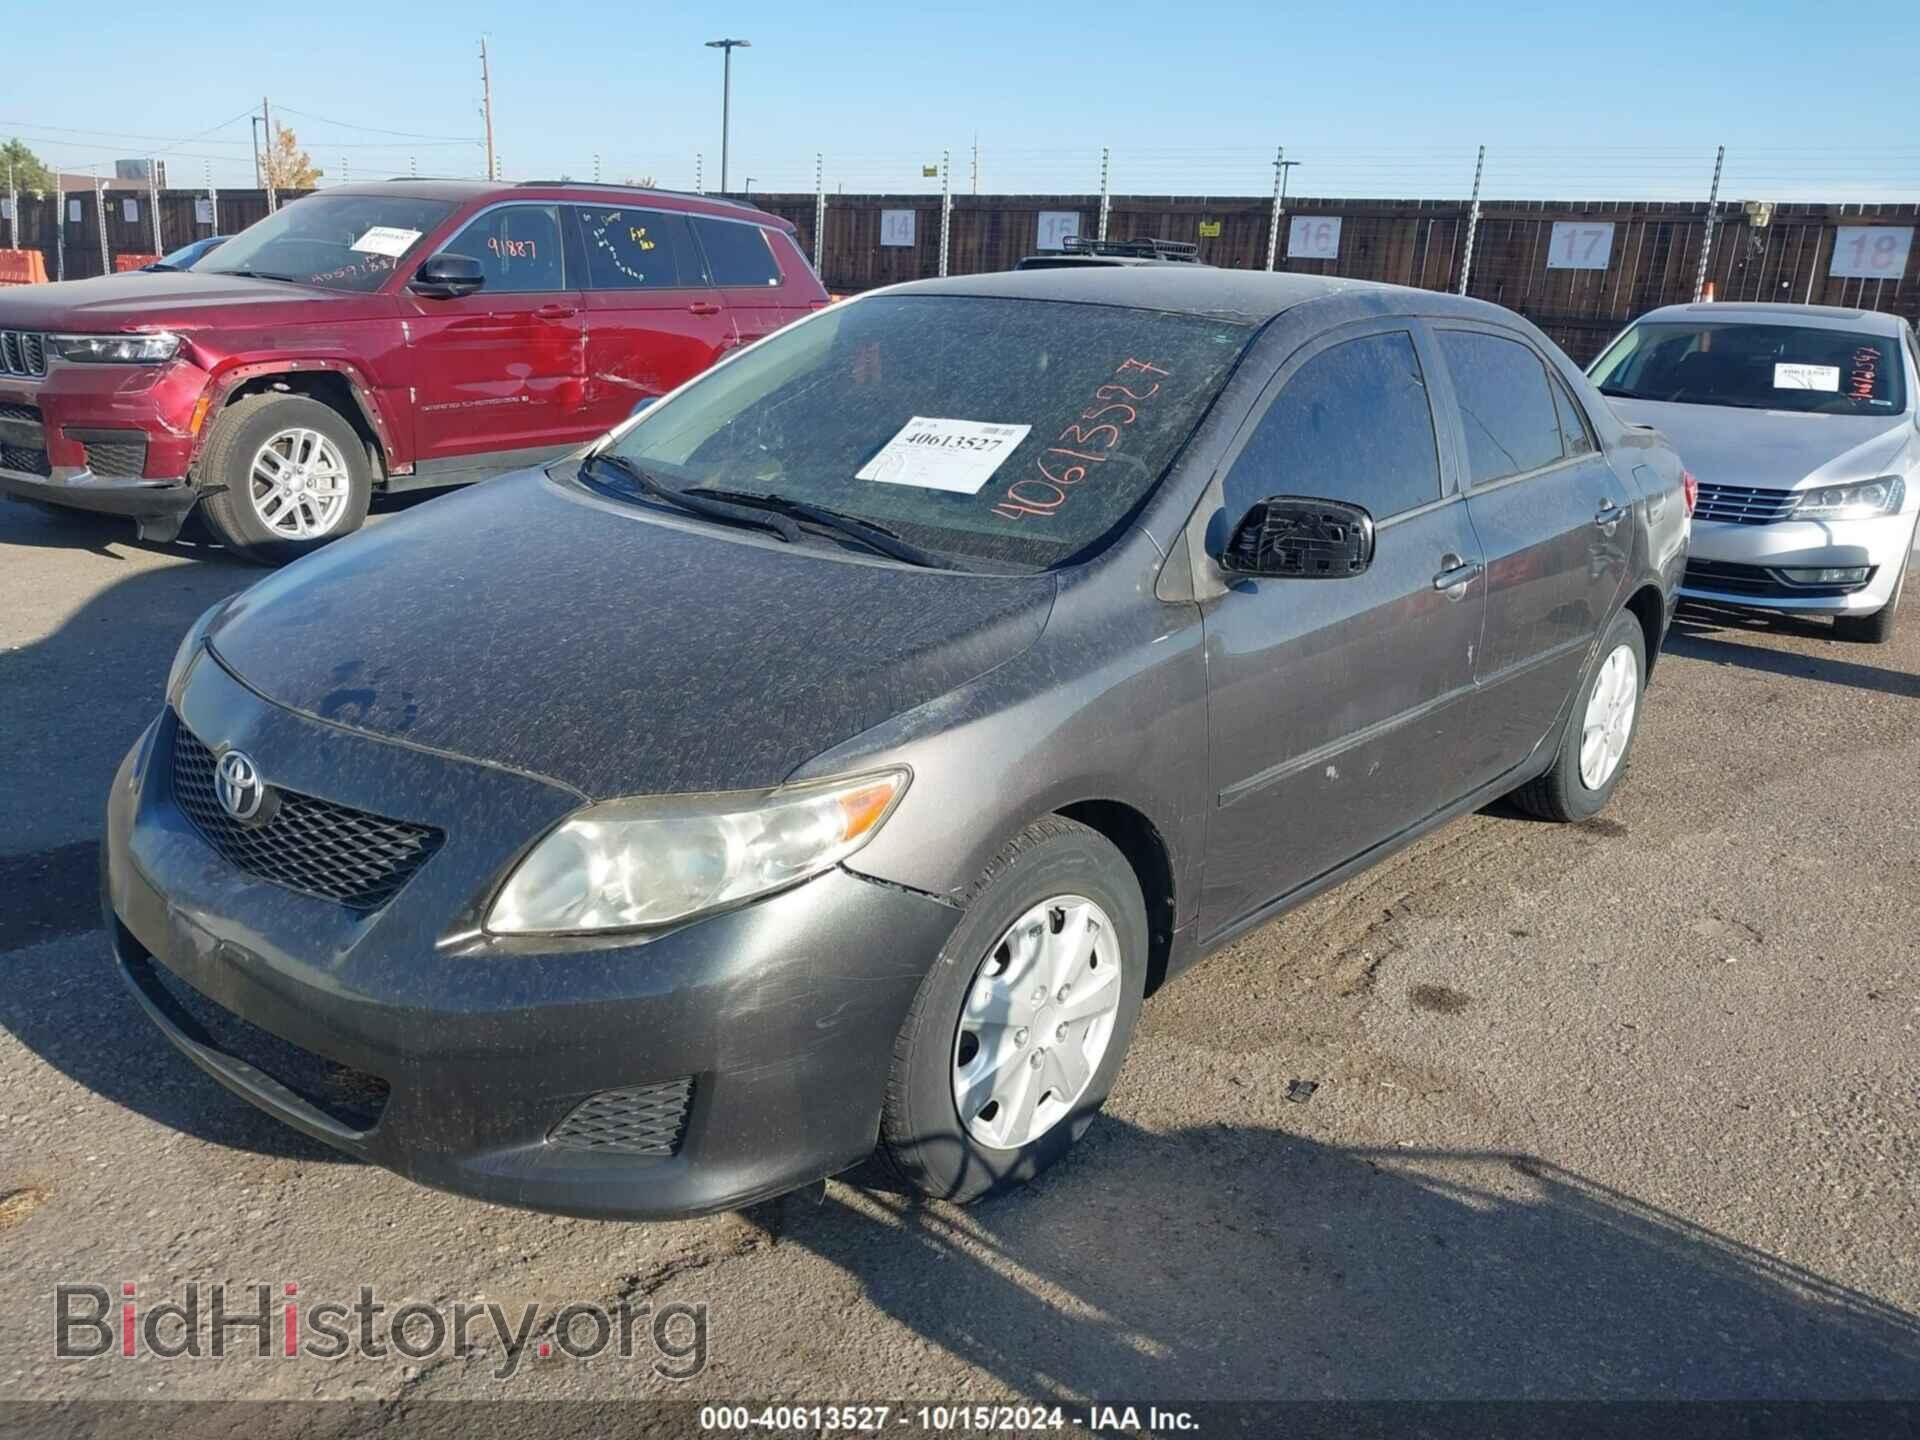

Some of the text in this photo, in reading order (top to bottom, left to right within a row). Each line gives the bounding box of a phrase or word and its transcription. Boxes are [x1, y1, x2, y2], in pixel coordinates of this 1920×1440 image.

[888, 215, 910, 239] 14
[1300, 222, 1331, 252] 16
[487, 237, 536, 261] 91887
[1562, 228, 1604, 261] 17
[1848, 233, 1897, 269] 18
[905, 432, 1003, 452] 40613527
[991, 357, 1170, 519] 40613527
